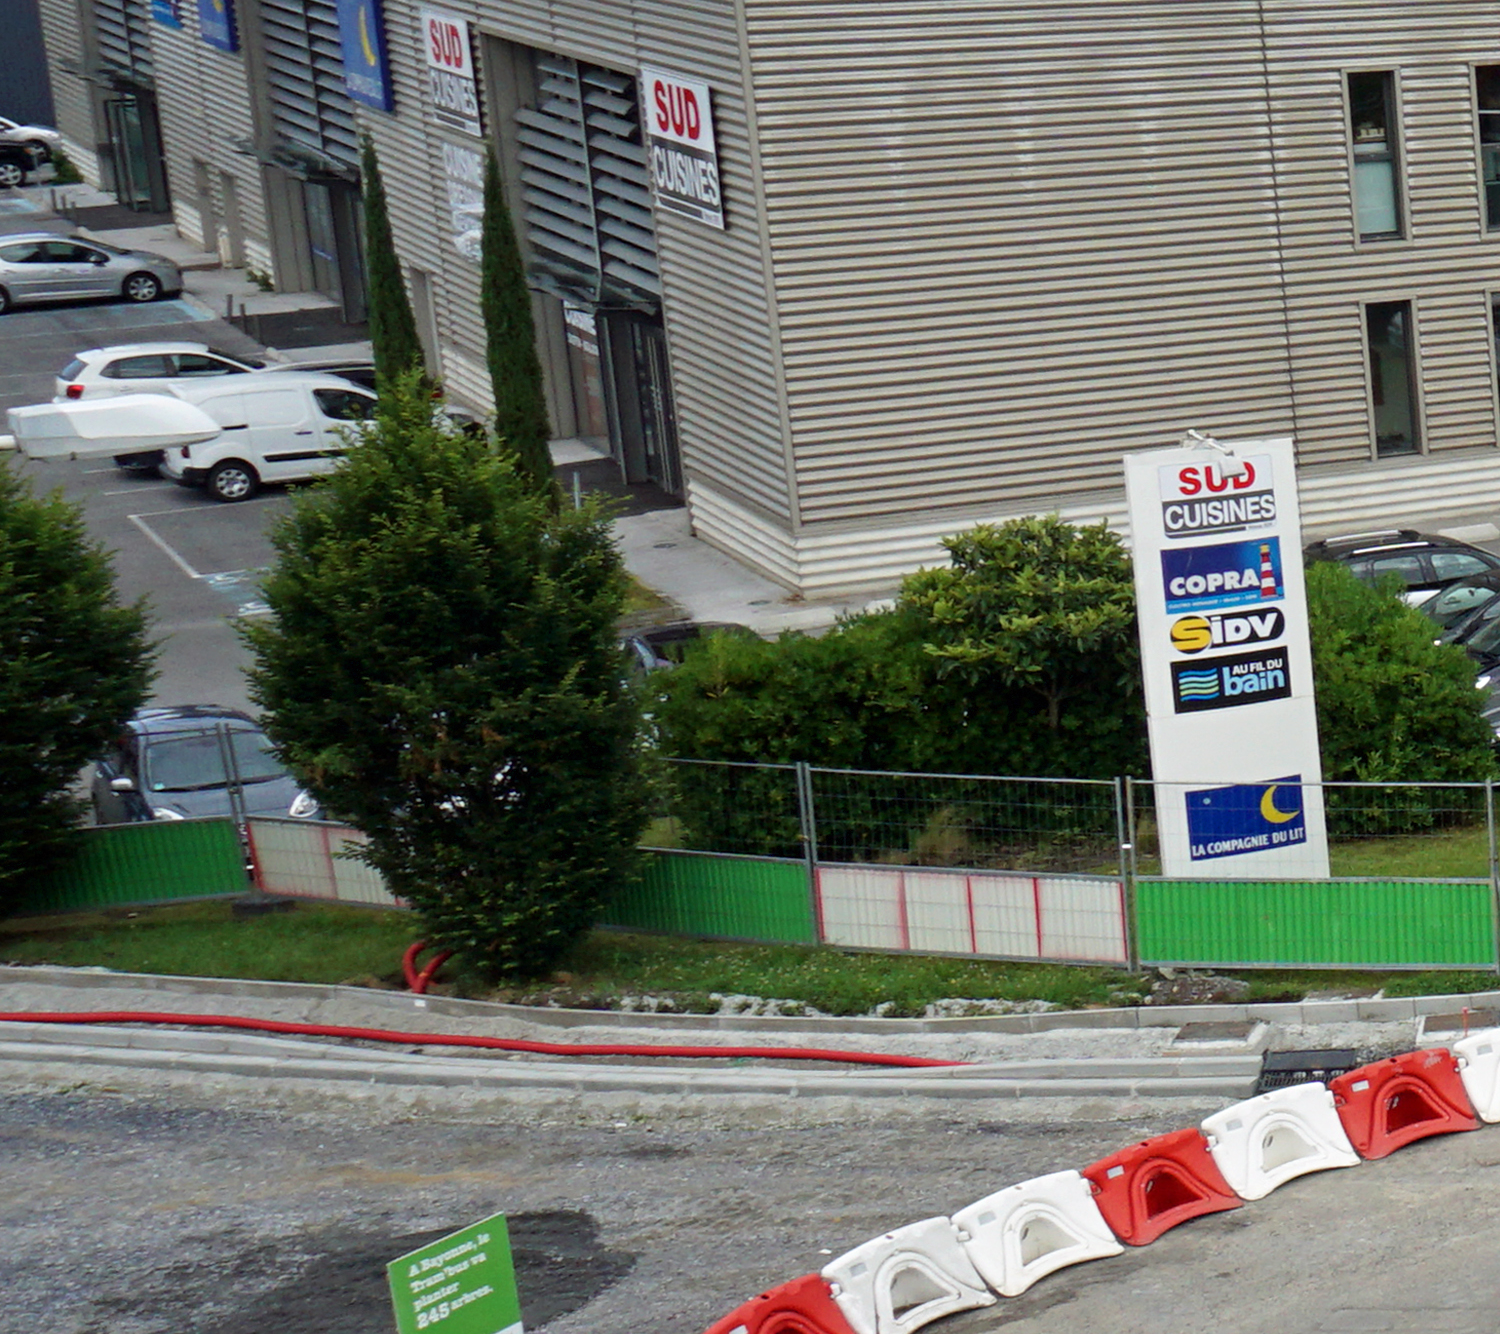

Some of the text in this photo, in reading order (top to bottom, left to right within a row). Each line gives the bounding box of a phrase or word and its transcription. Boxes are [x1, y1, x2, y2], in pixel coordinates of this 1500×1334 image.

[429, 18, 462, 69] SUD
[654, 79, 700, 140] SUD
[653, 145, 720, 206] CUISINES
[1178, 461, 1255, 496] SUD
[1164, 495, 1276, 530] CUISINES
[1169, 568, 1260, 597] COPRA
[1222, 666, 1285, 697] bain
[1232, 658, 1283, 675] AU FIL DU
[1192, 826, 1304, 857] LA COMPAGNIE DU LIT
[413, 1282, 460, 1313] planter
[417, 1284, 494, 1330] 245 arbres.
